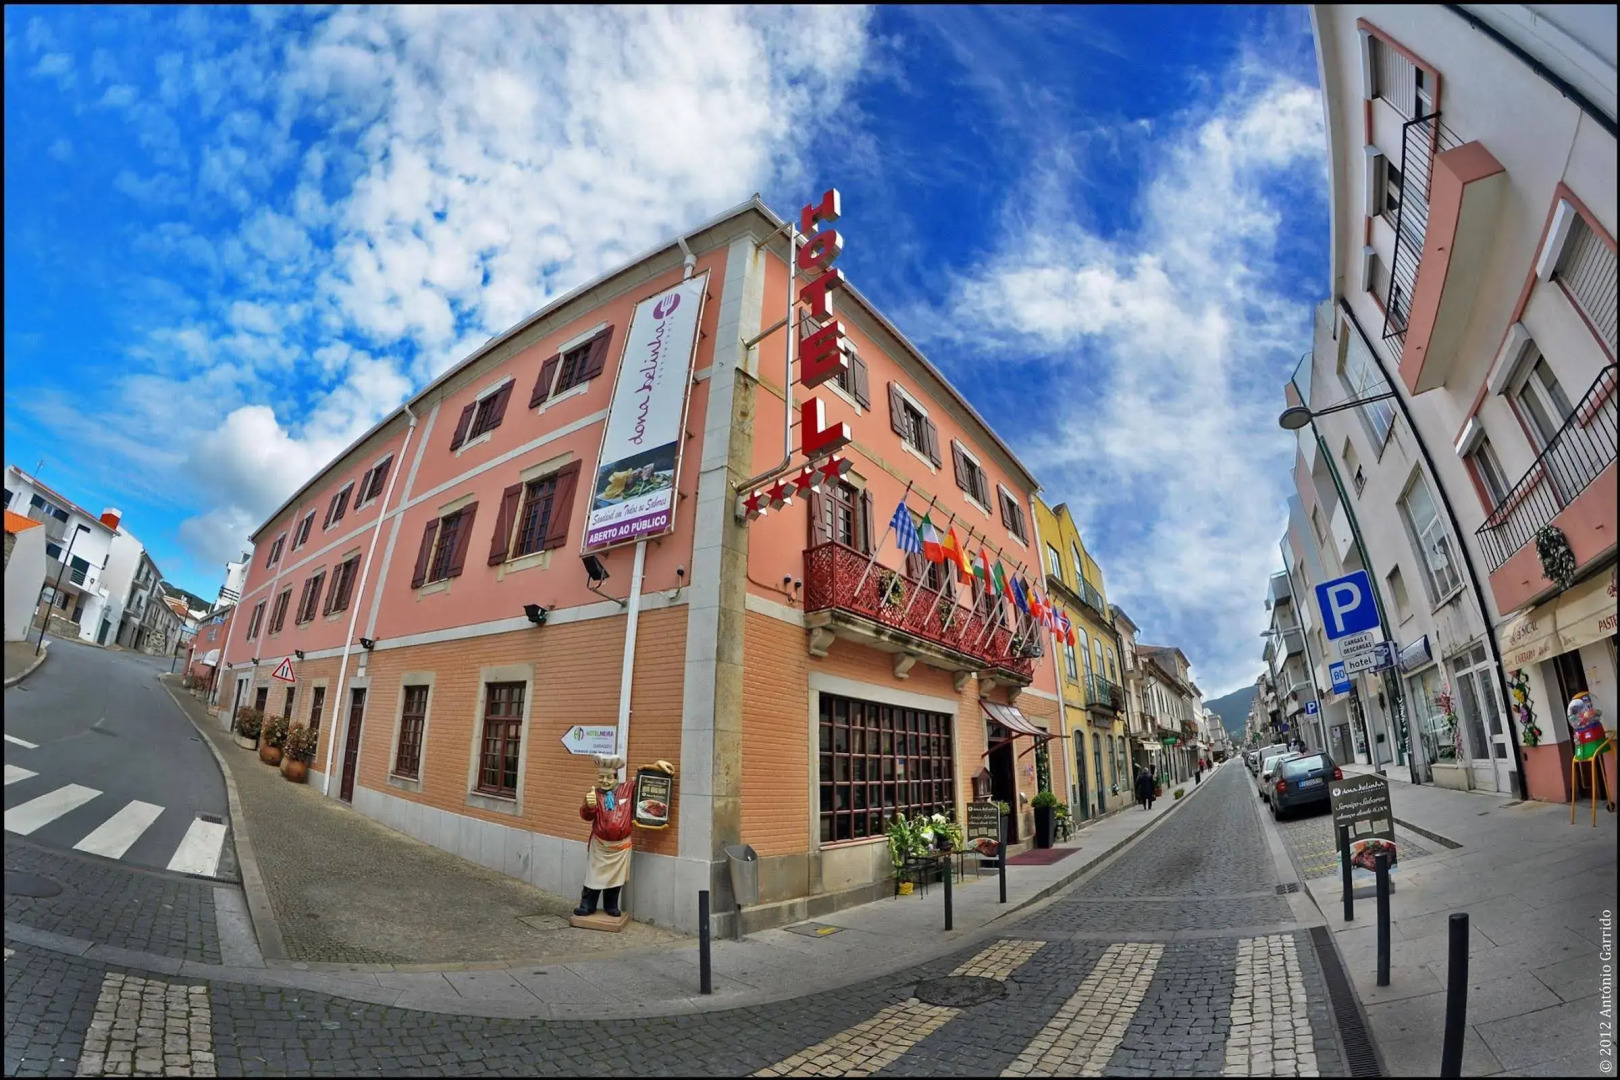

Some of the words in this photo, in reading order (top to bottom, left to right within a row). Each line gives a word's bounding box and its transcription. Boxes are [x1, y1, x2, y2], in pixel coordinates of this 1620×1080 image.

[797, 188, 852, 460] HOTEL
[629, 395, 650, 445] dona
[589, 527, 617, 544] ABERTO
[618, 524, 630, 536] AO
[631, 514, 667, 533] PÚBLICO
[1327, 582, 1361, 632] P
[1343, 641, 1373, 655] DESCARGAS
[1344, 637, 1364, 647] CARGAS
[1349, 656, 1373, 669] hotel
[1308, 702, 1316, 714] P
